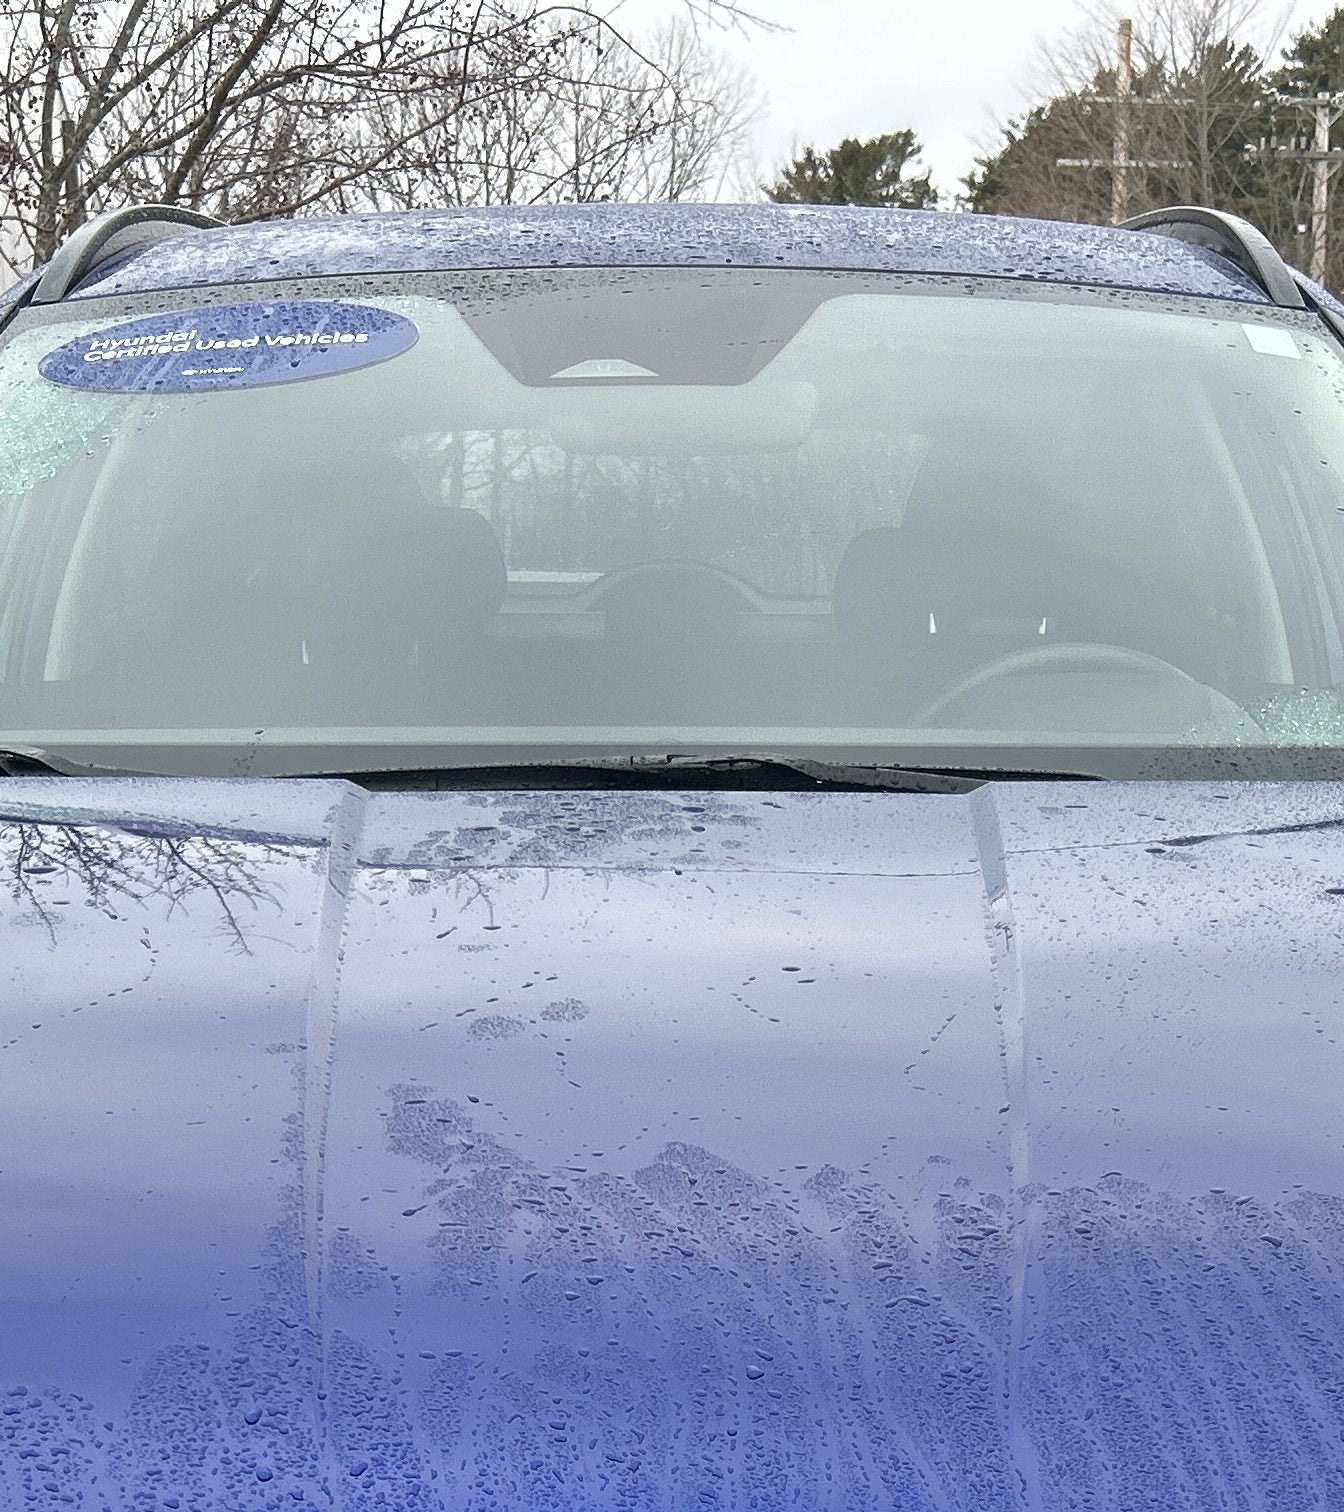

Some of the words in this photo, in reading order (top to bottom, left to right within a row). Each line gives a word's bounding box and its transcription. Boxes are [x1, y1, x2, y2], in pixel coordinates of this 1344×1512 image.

[83, 341, 191, 362] Certified
[195, 335, 260, 350] Used
[264, 332, 368, 346] Vehicles
[88, 329, 198, 351] Hyundai
